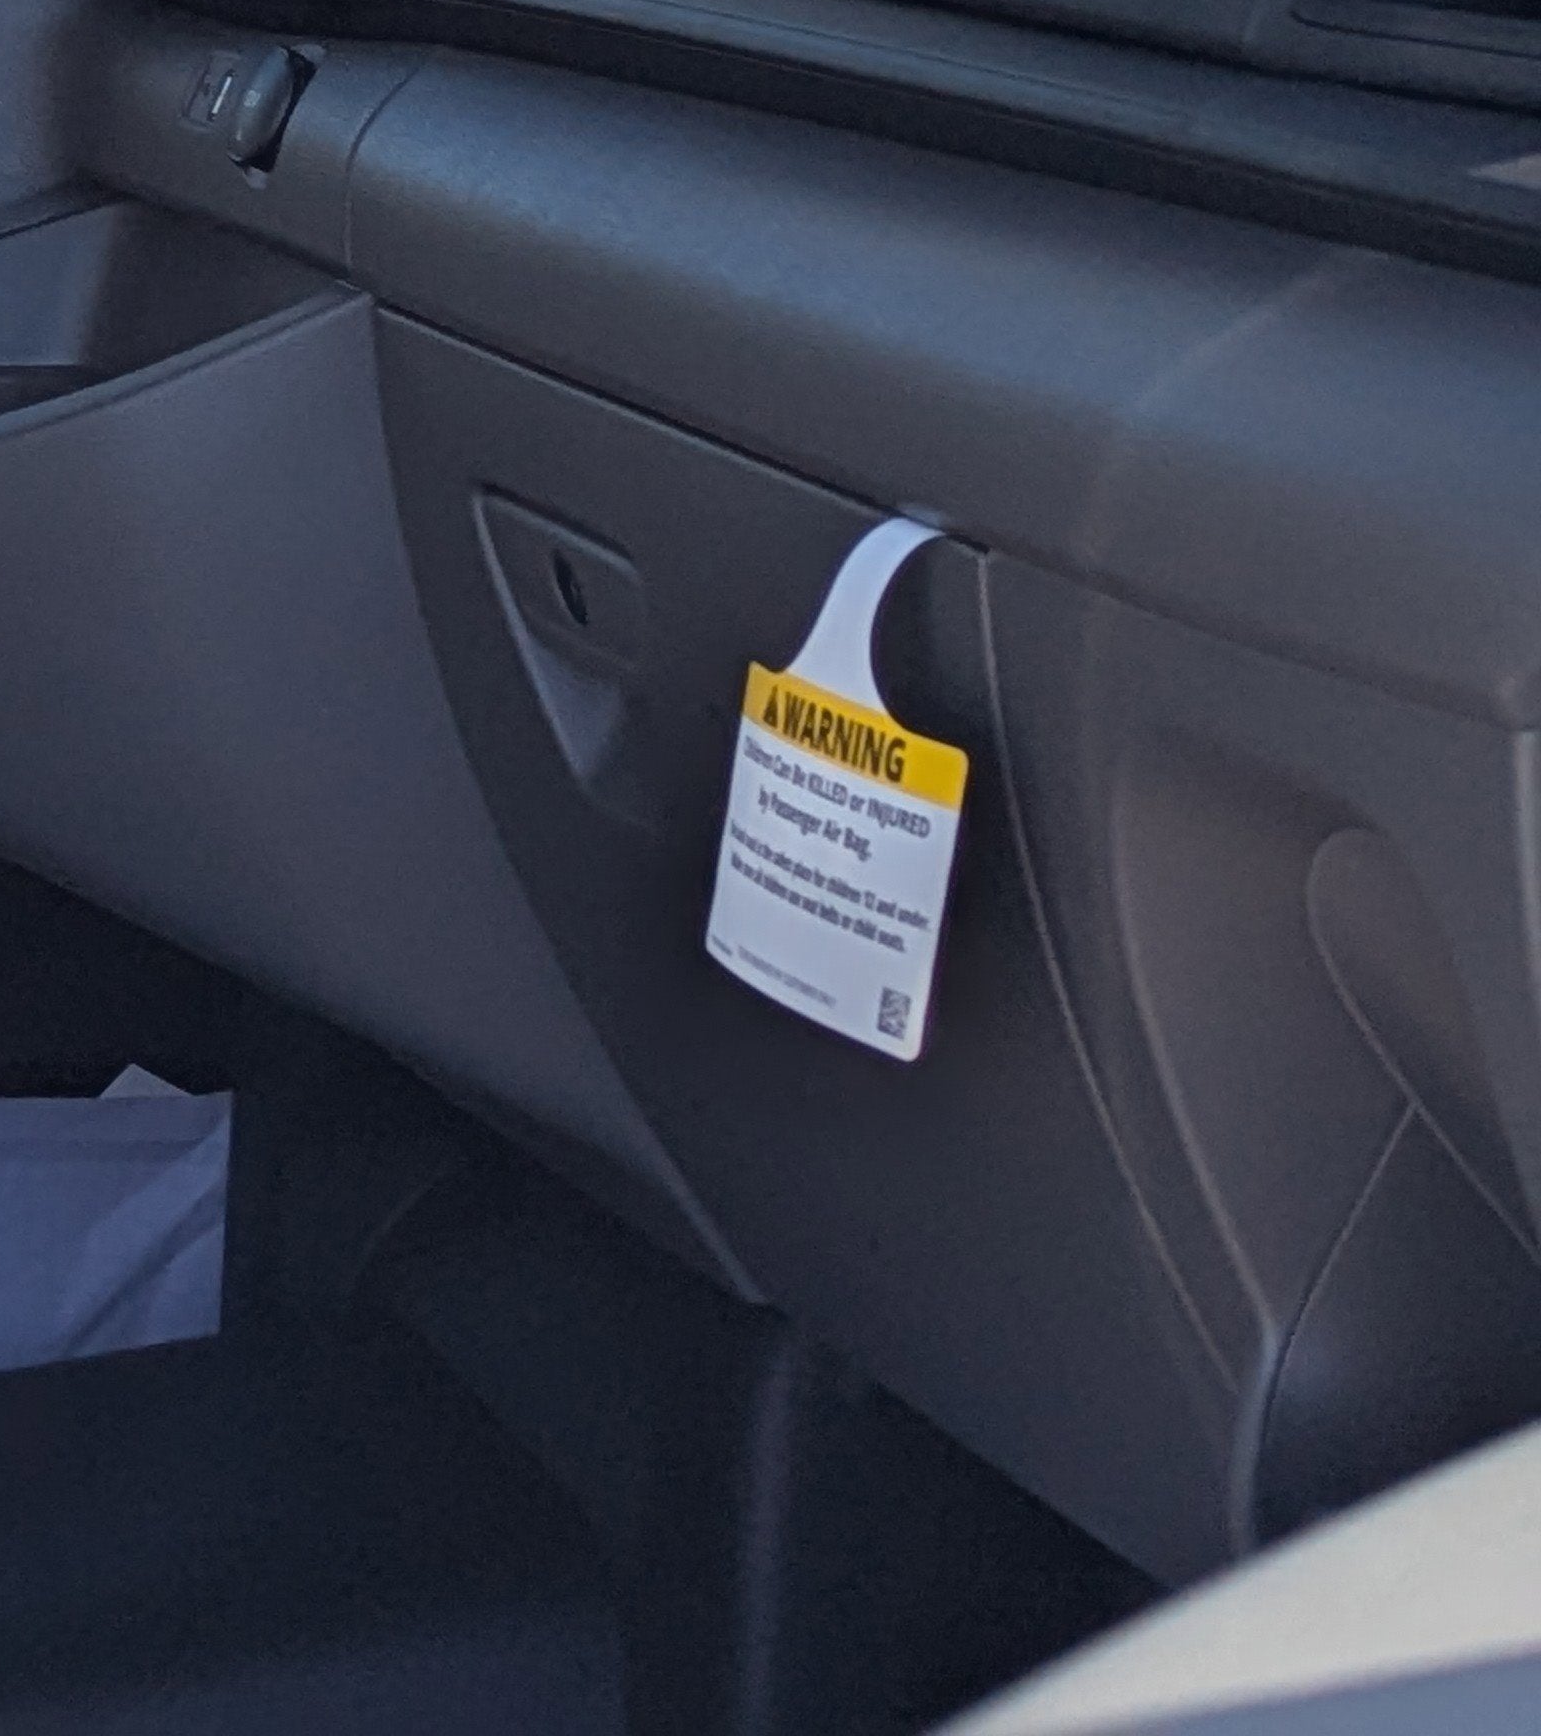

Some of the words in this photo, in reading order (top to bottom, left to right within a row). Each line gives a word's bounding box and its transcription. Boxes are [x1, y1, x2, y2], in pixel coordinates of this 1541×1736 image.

[783, 691, 907, 782] WARNING
[808, 772, 848, 806] KILLED
[850, 794, 866, 813] or
[867, 797, 931, 839] INJURED
